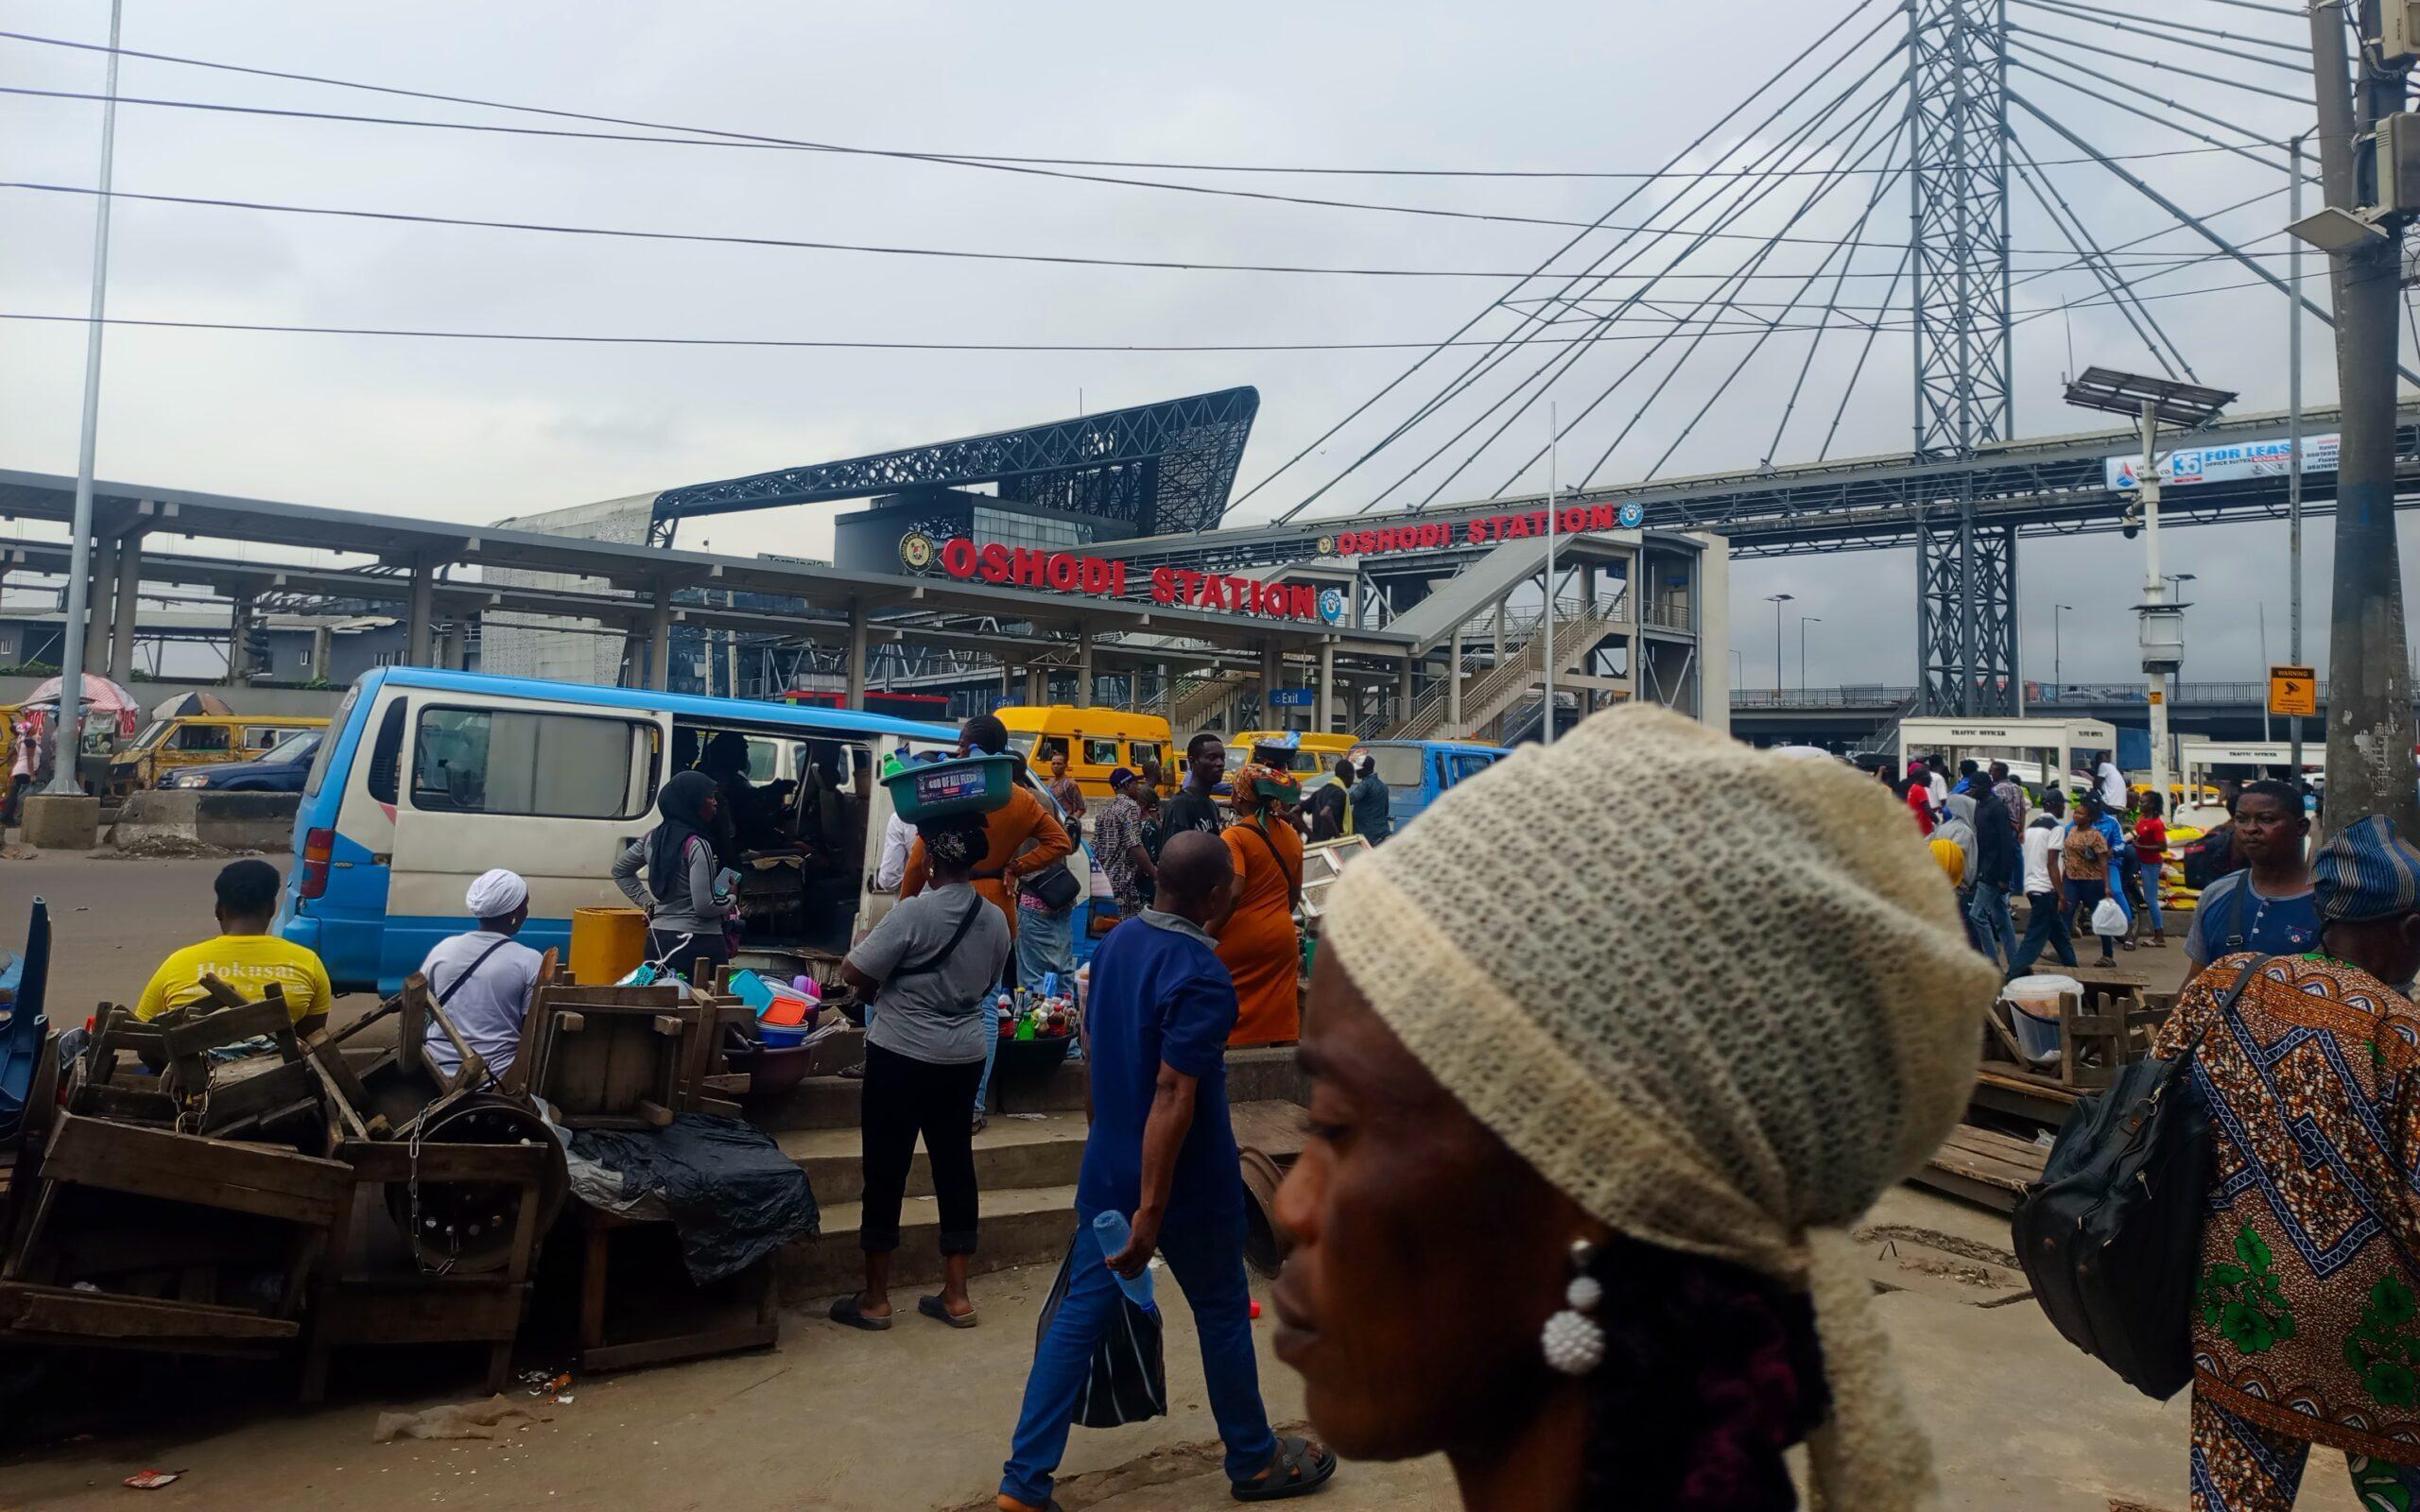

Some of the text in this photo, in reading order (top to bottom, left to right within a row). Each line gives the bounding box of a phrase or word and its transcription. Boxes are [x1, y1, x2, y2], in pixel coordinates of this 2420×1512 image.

[2205, 449, 2239, 461] FOR
[2246, 443, 2302, 457] LEAS
[2174, 454, 2202, 475] 35
[1338, 503, 1614, 555] OSHODI STATION
[943, 538, 1315, 619] OSHODI STATION
[1282, 693, 1299, 703] Exit
[928, 778, 942, 789] GOD
[942, 776, 949, 787] OF
[950, 774, 960, 786] ALL
[197, 961, 295, 978] Hokusai
